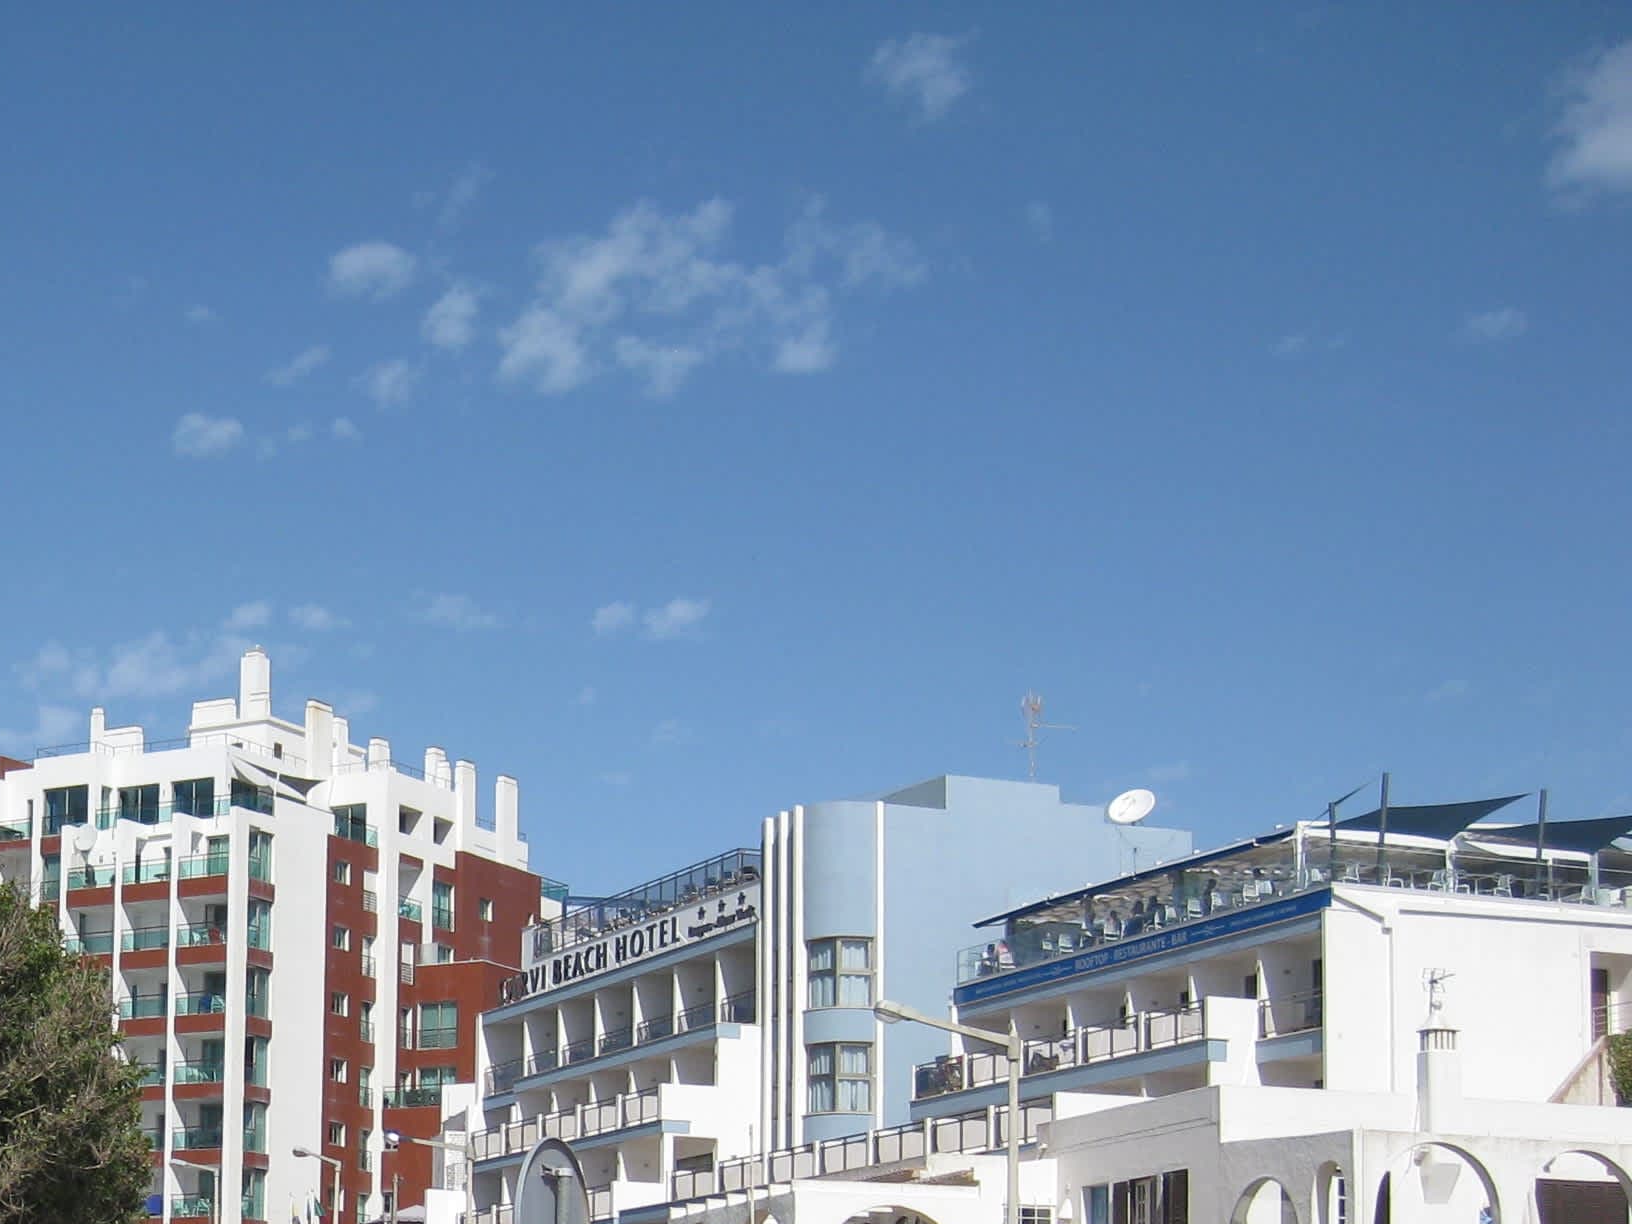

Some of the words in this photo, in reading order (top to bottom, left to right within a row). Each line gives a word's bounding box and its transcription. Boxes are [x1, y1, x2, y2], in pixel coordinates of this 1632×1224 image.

[552, 942, 608, 985] BEACH
[615, 916, 681, 963] HOTEL
[1113, 936, 1167, 960] RESTAURANTE
